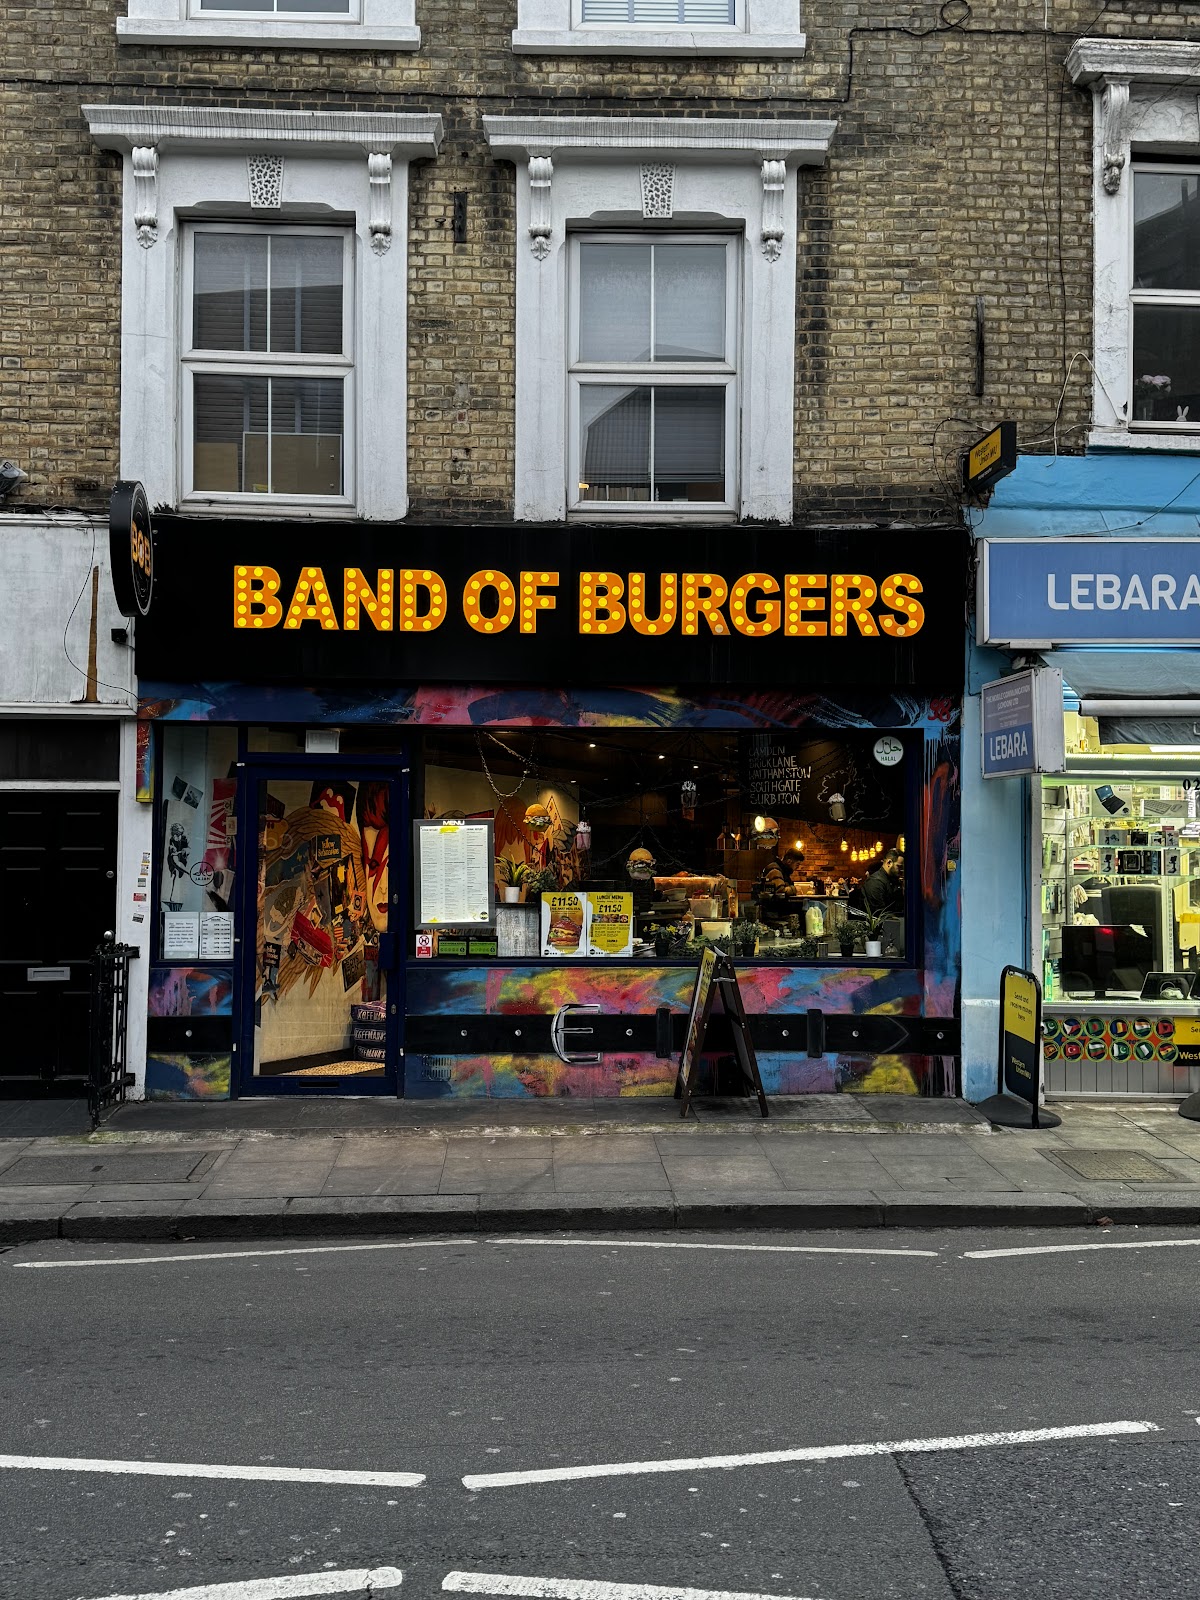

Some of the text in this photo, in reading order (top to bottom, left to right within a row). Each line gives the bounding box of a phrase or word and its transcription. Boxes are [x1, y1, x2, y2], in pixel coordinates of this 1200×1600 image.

[131, 520, 151, 577] BOB
[1047, 574, 1200, 611] LEBARA
[233, 565, 925, 637] BAND OF BURGERS
[989, 731, 1028, 761] LEBARA
[772, 755, 798, 768] LANE
[750, 779, 802, 793] SOUTHGATE
[750, 792, 801, 806] SURBITON
[551, 896, 579, 907] £11.50
[598, 904, 622, 913] £11.50
